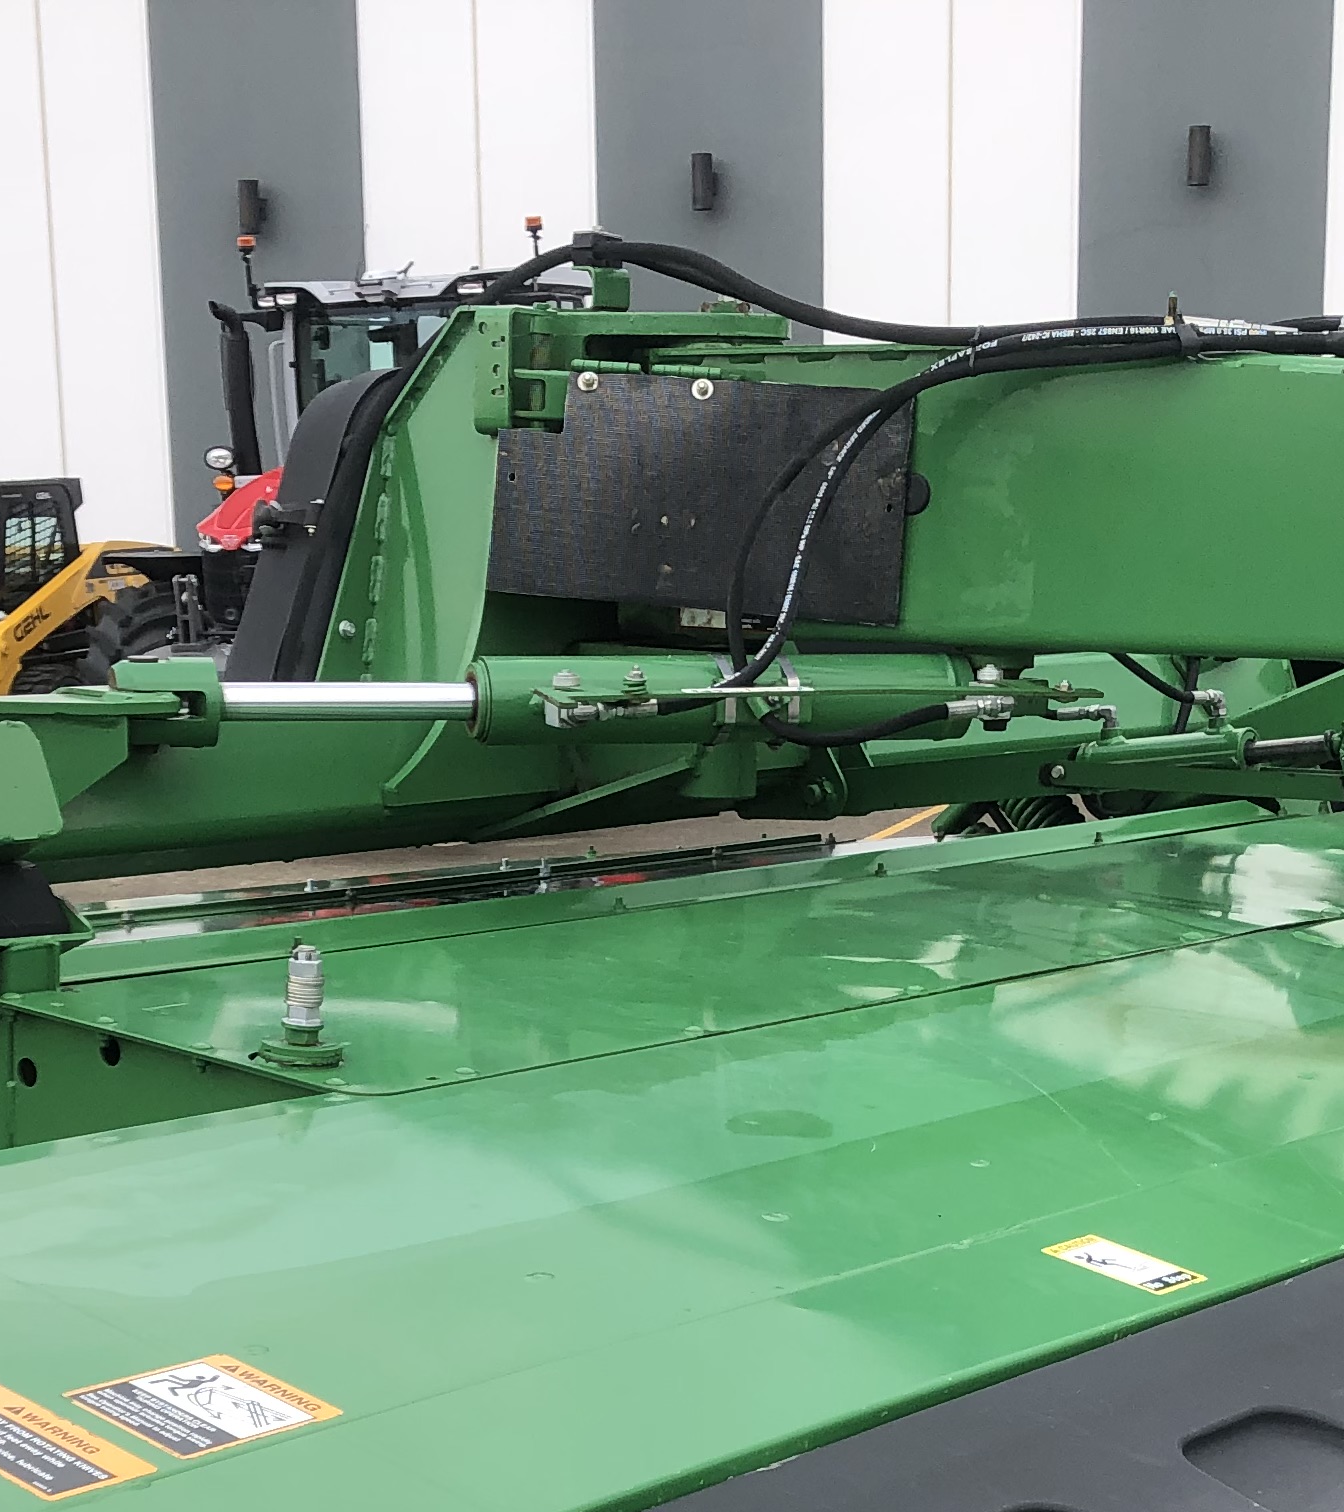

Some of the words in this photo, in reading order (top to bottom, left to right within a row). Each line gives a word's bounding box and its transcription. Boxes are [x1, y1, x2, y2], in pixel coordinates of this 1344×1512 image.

[14, 606, 52, 642] GEHL
[239, 1371, 321, 1411] WARNING
[5, 1424, 33, 1438] FROM
[30, 1437, 76, 1462] ROTATING
[73, 1461, 108, 1479] KNIVES
[22, 1413, 99, 1454] WARNING
[16, 1459, 53, 1480] lubricate
[20, 1443, 43, 1455] away
[42, 1455, 65, 1467] while
